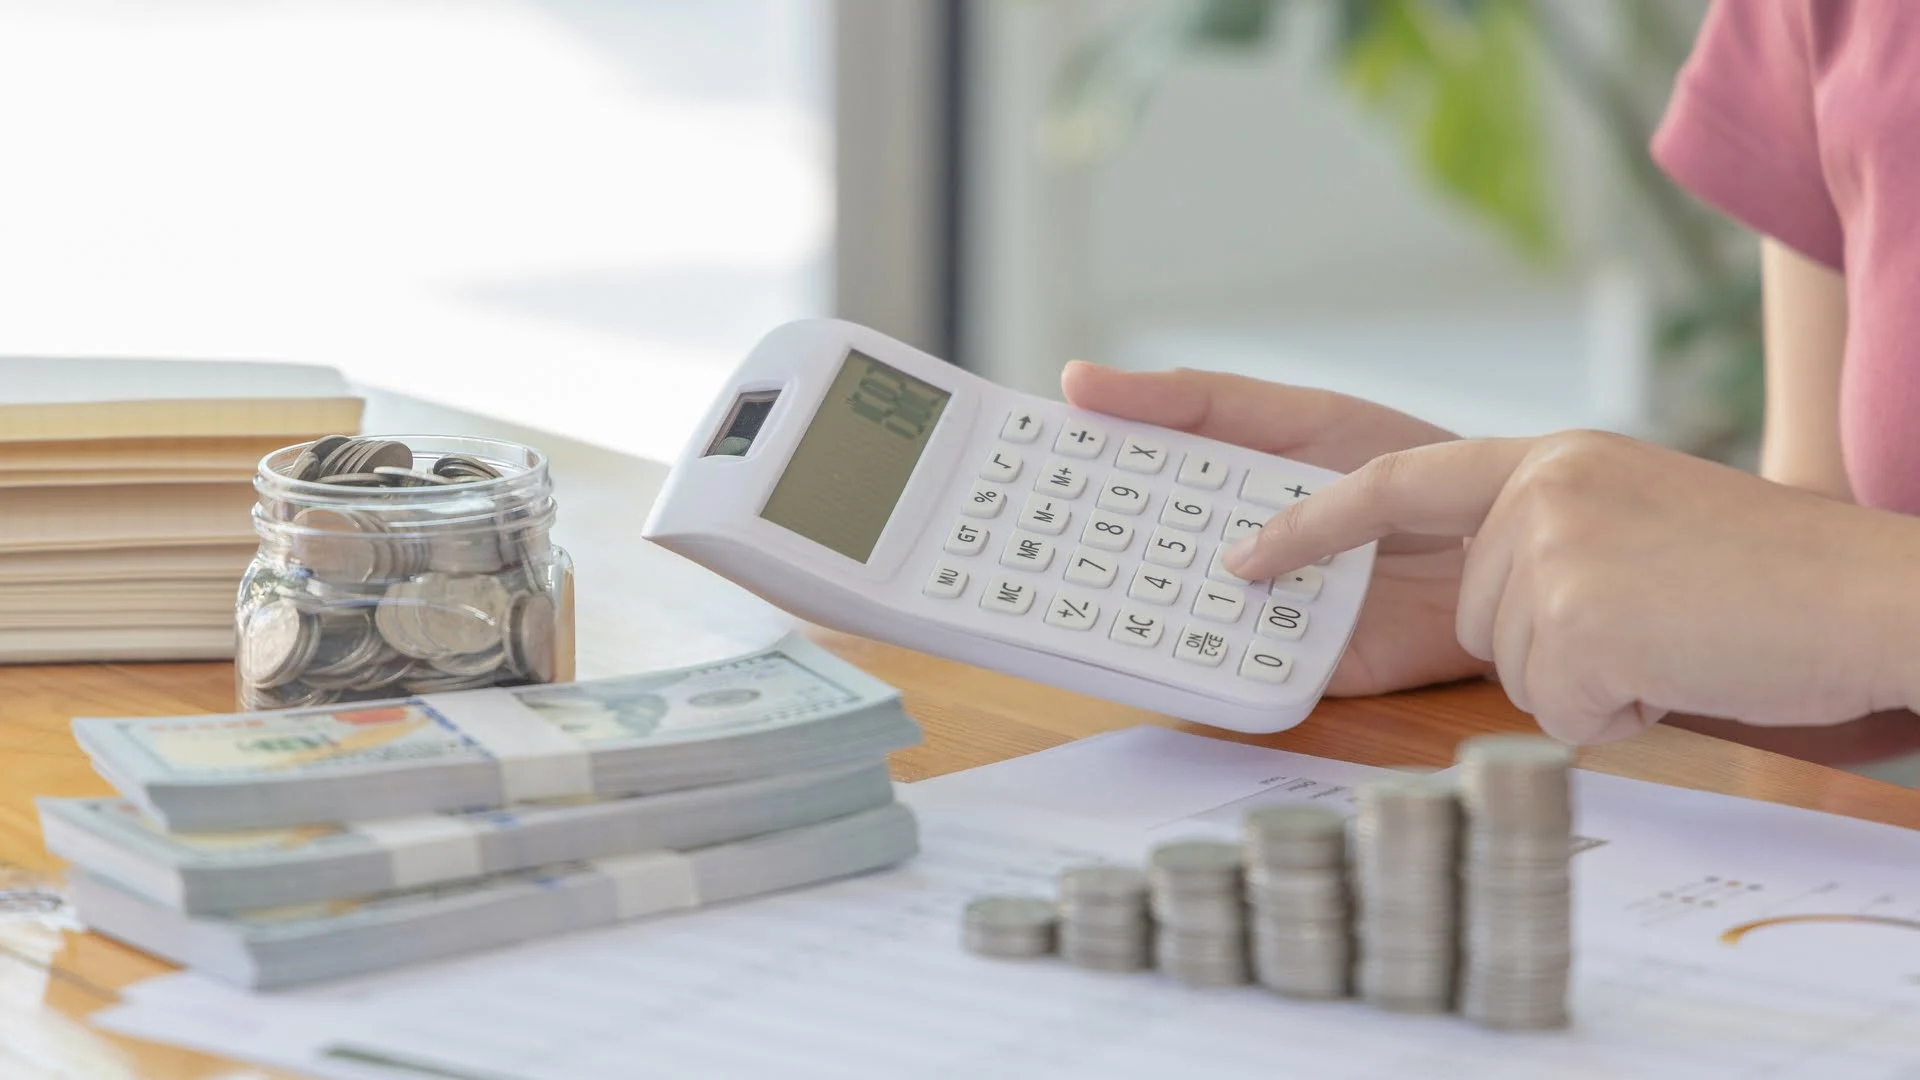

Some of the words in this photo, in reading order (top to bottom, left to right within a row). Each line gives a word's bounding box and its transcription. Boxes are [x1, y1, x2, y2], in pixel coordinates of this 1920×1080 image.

[1050, 467, 1072, 487] M+
[1111, 486, 1140, 500] 9
[1174, 501, 1203, 515] 6
[1094, 521, 1124, 536] 8
[1236, 519, 1264, 529] 3
[957, 524, 979, 543] GT
[1016, 539, 1042, 560] MR
[1157, 538, 1187, 553] 5
[1077, 557, 1107, 572] 7
[936, 568, 959, 587] MU
[1143, 575, 1172, 590] 4
[996, 582, 1023, 604] MC
[1207, 593, 1236, 604] 1
[1268, 605, 1302, 629] 00
[1125, 614, 1154, 638] AC
[1185, 632, 1204, 649] ON
[1253, 654, 1283, 668] 0
